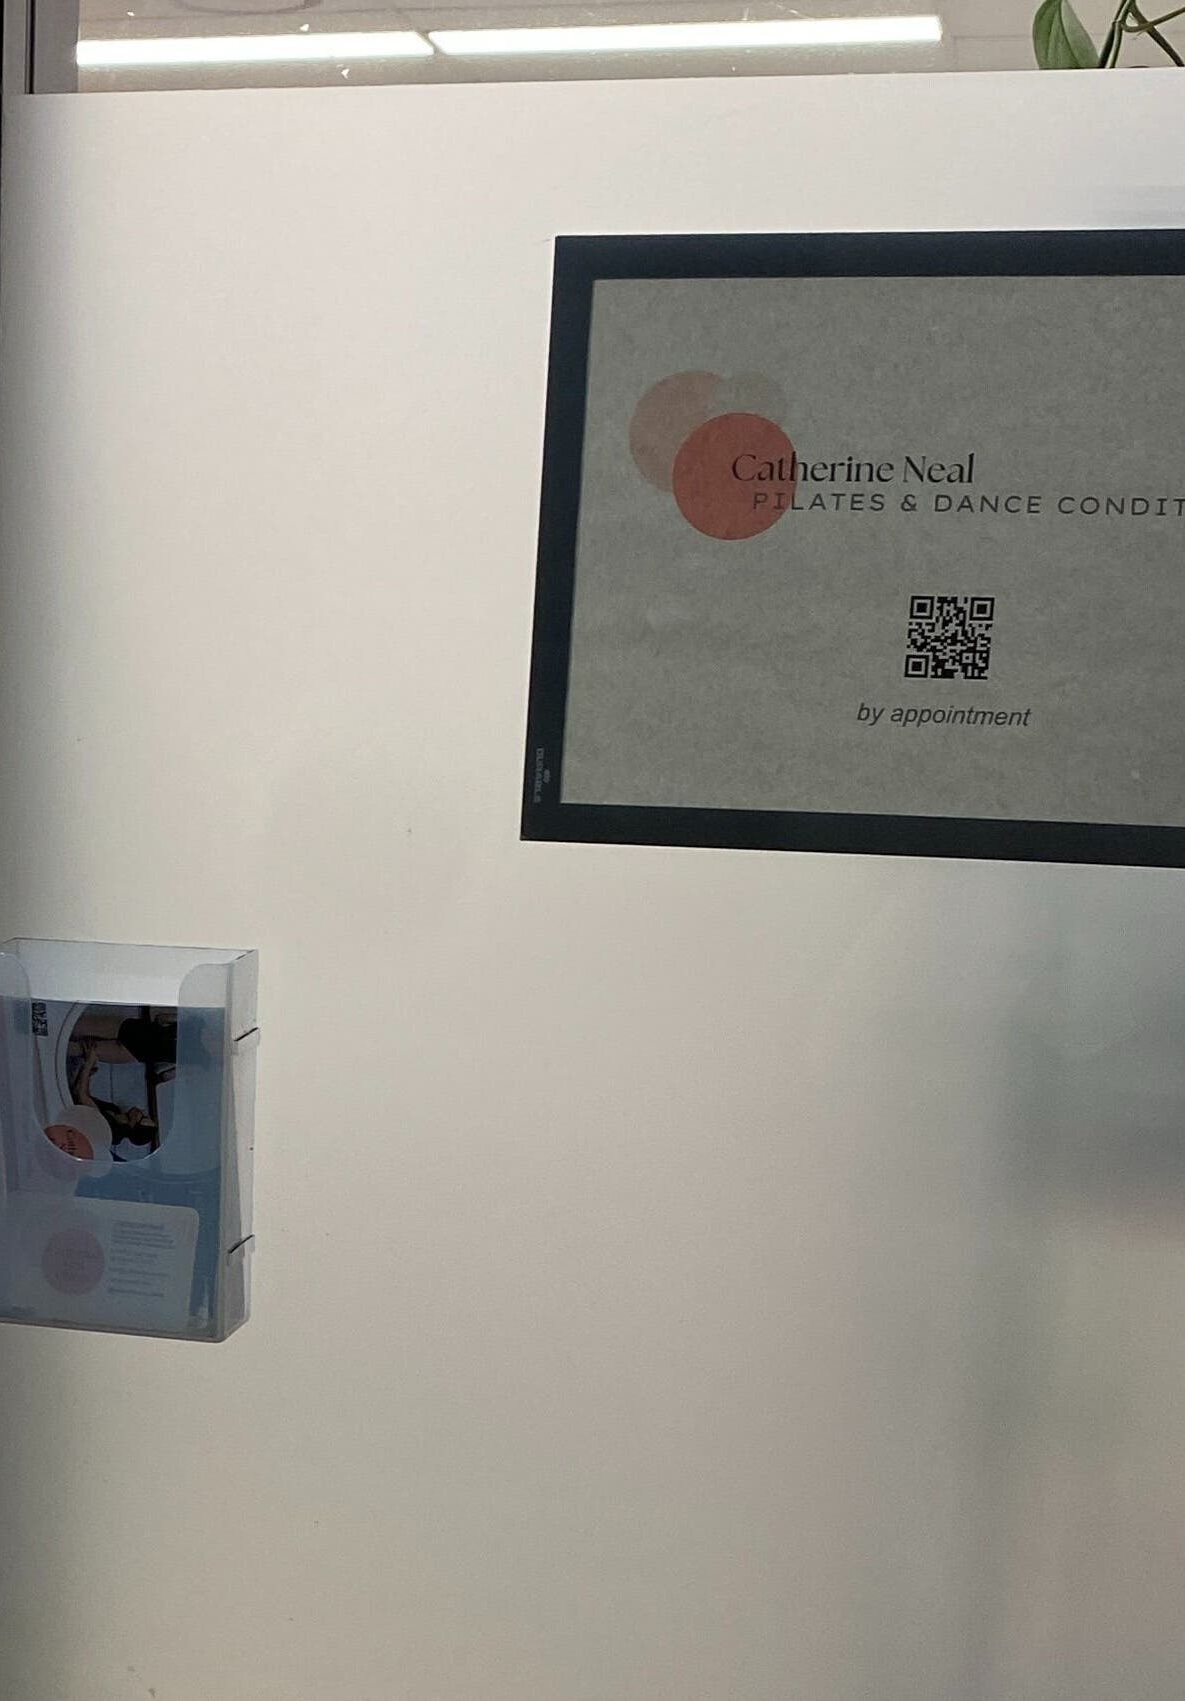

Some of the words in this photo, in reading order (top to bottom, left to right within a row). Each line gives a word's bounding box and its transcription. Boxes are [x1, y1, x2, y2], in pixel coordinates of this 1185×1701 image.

[731, 451, 895, 483] Catherine
[902, 452, 975, 484] Neal
[752, 492, 886, 512] PILATES
[900, 493, 919, 513] &
[933, 494, 1042, 514] DANCE
[856, 702, 885, 727] by
[890, 704, 1032, 728] appointment
